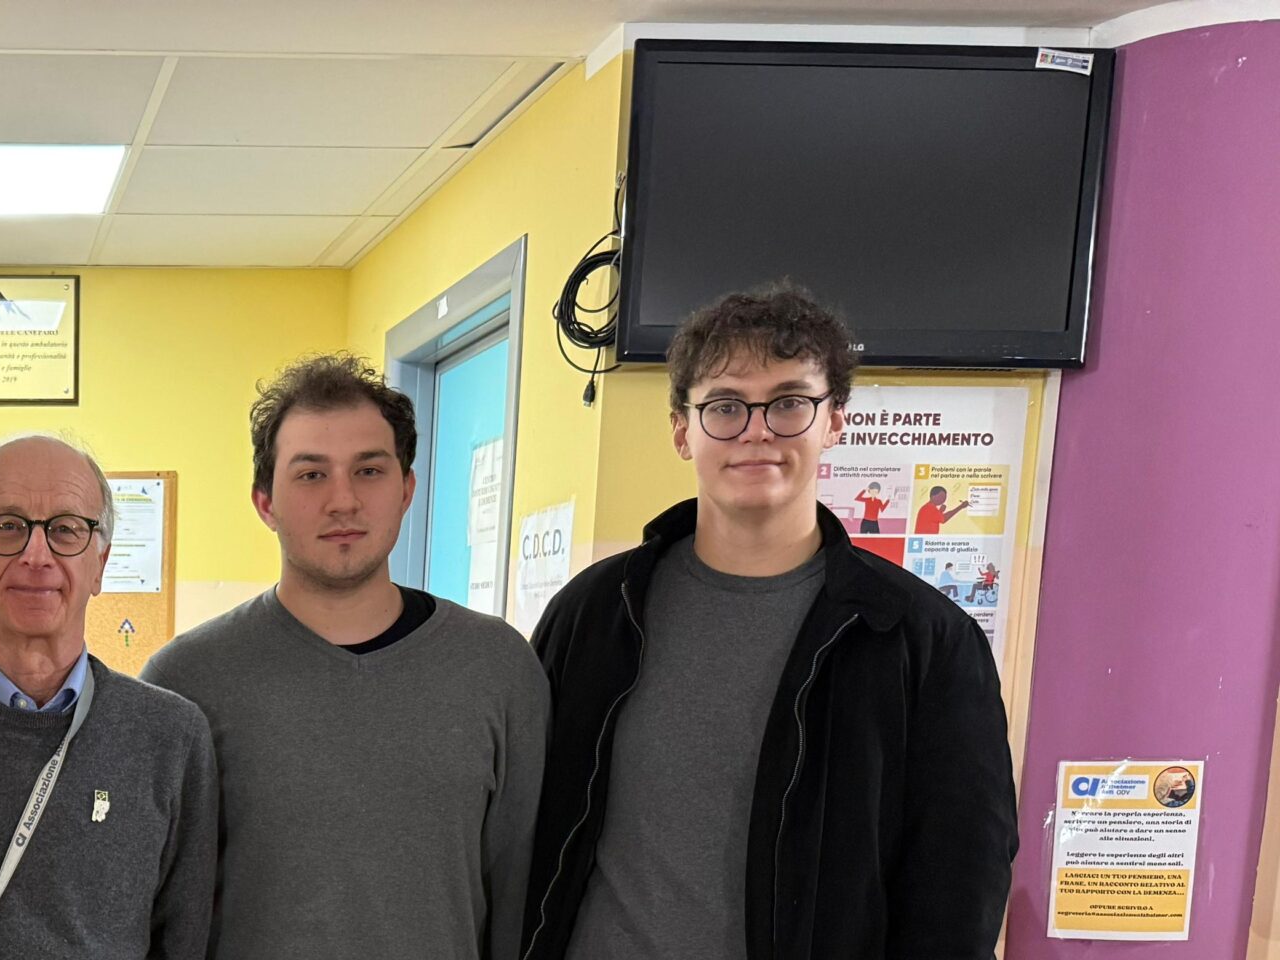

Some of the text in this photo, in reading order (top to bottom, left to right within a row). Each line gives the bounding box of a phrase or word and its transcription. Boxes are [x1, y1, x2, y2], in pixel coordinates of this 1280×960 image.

[879, 409, 890, 426] È
[892, 413, 942, 426] PARTE
[850, 432, 995, 446] INVECCHIAMENTO
[821, 466, 828, 475] 2
[918, 467, 926, 475] 3
[522, 528, 565, 560] C.D.C.D.
[912, 541, 920, 549] 5
[23, 759, 58, 830] Associazione
